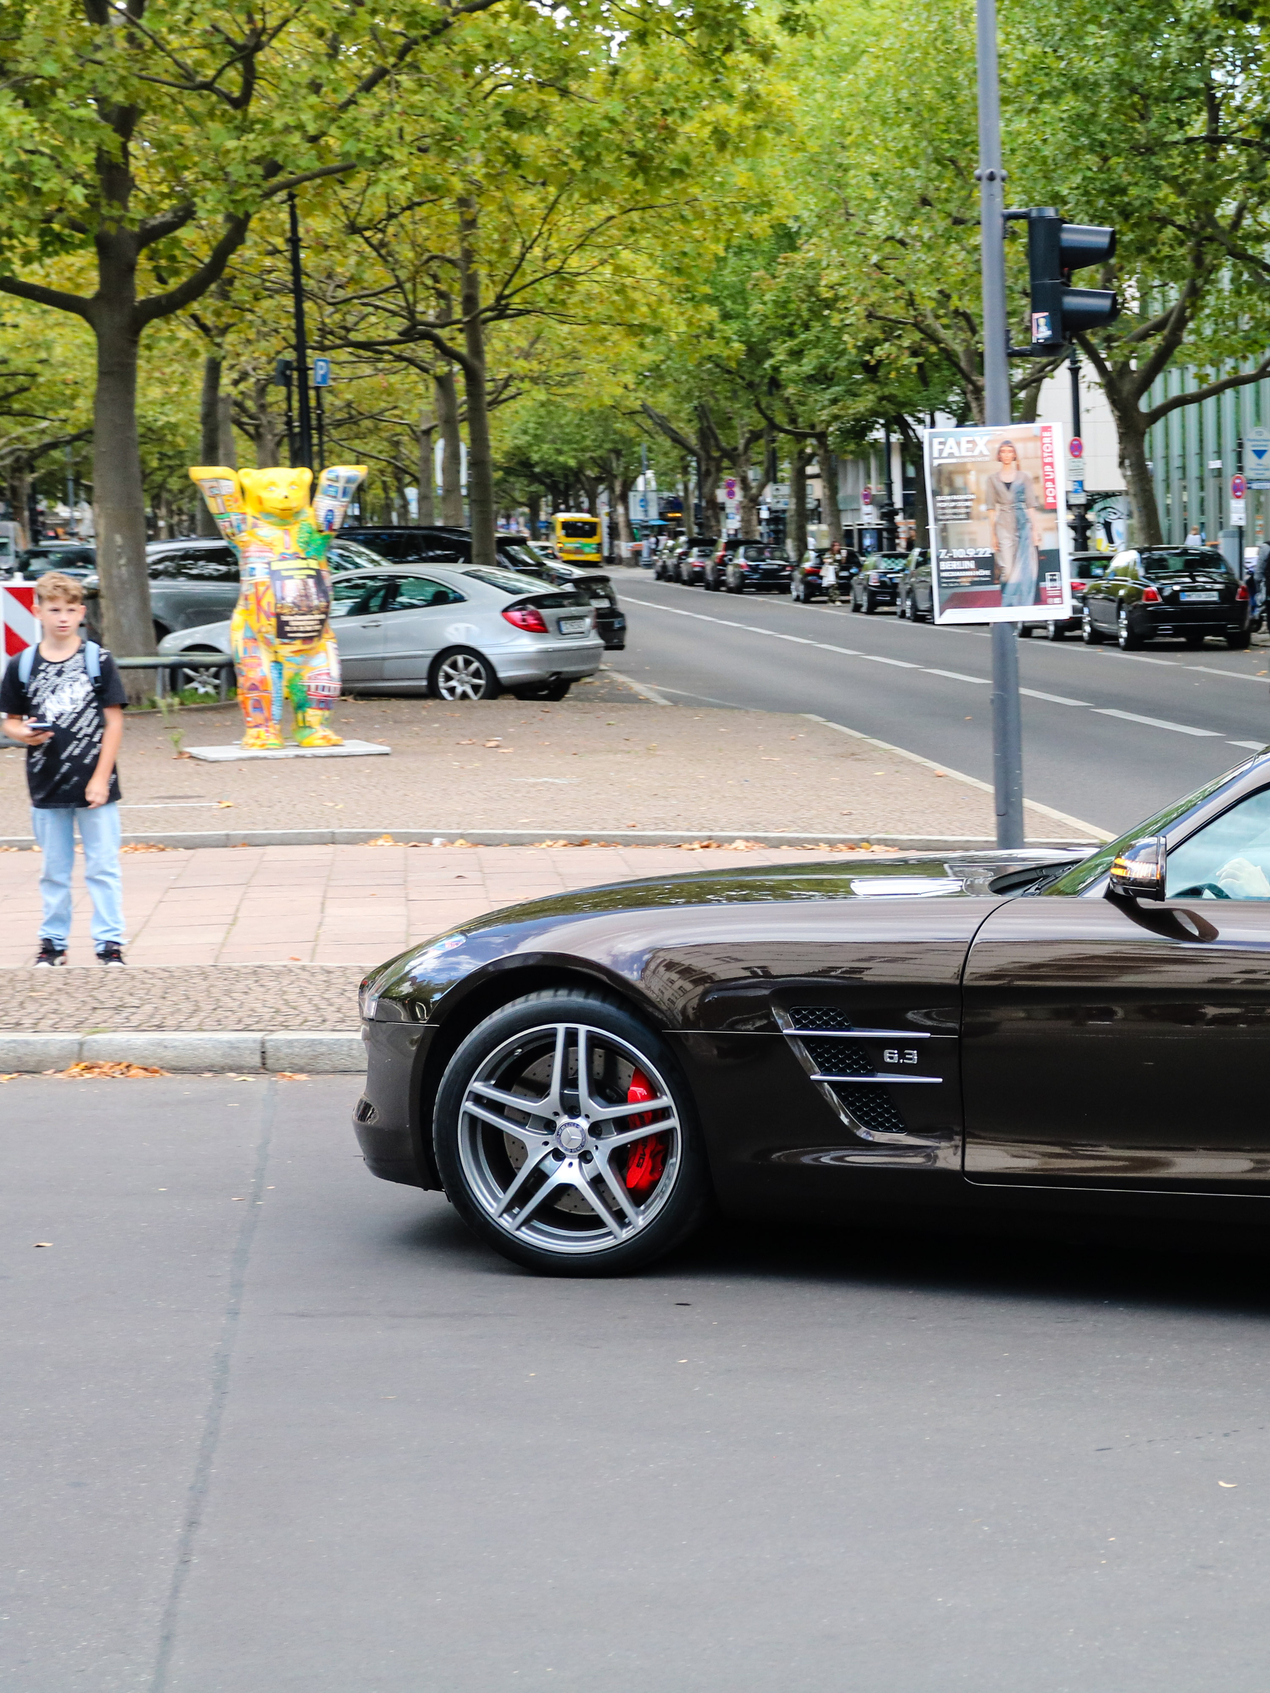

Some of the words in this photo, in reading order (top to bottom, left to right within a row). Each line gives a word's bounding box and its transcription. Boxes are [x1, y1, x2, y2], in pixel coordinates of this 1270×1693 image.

[316, 361, 327, 382] P
[933, 436, 990, 458] FAEX
[1043, 465, 1055, 481] UP
[1045, 482, 1056, 503] POP
[939, 560, 976, 570] BERLIN
[883, 1049, 918, 1064] 6.3
